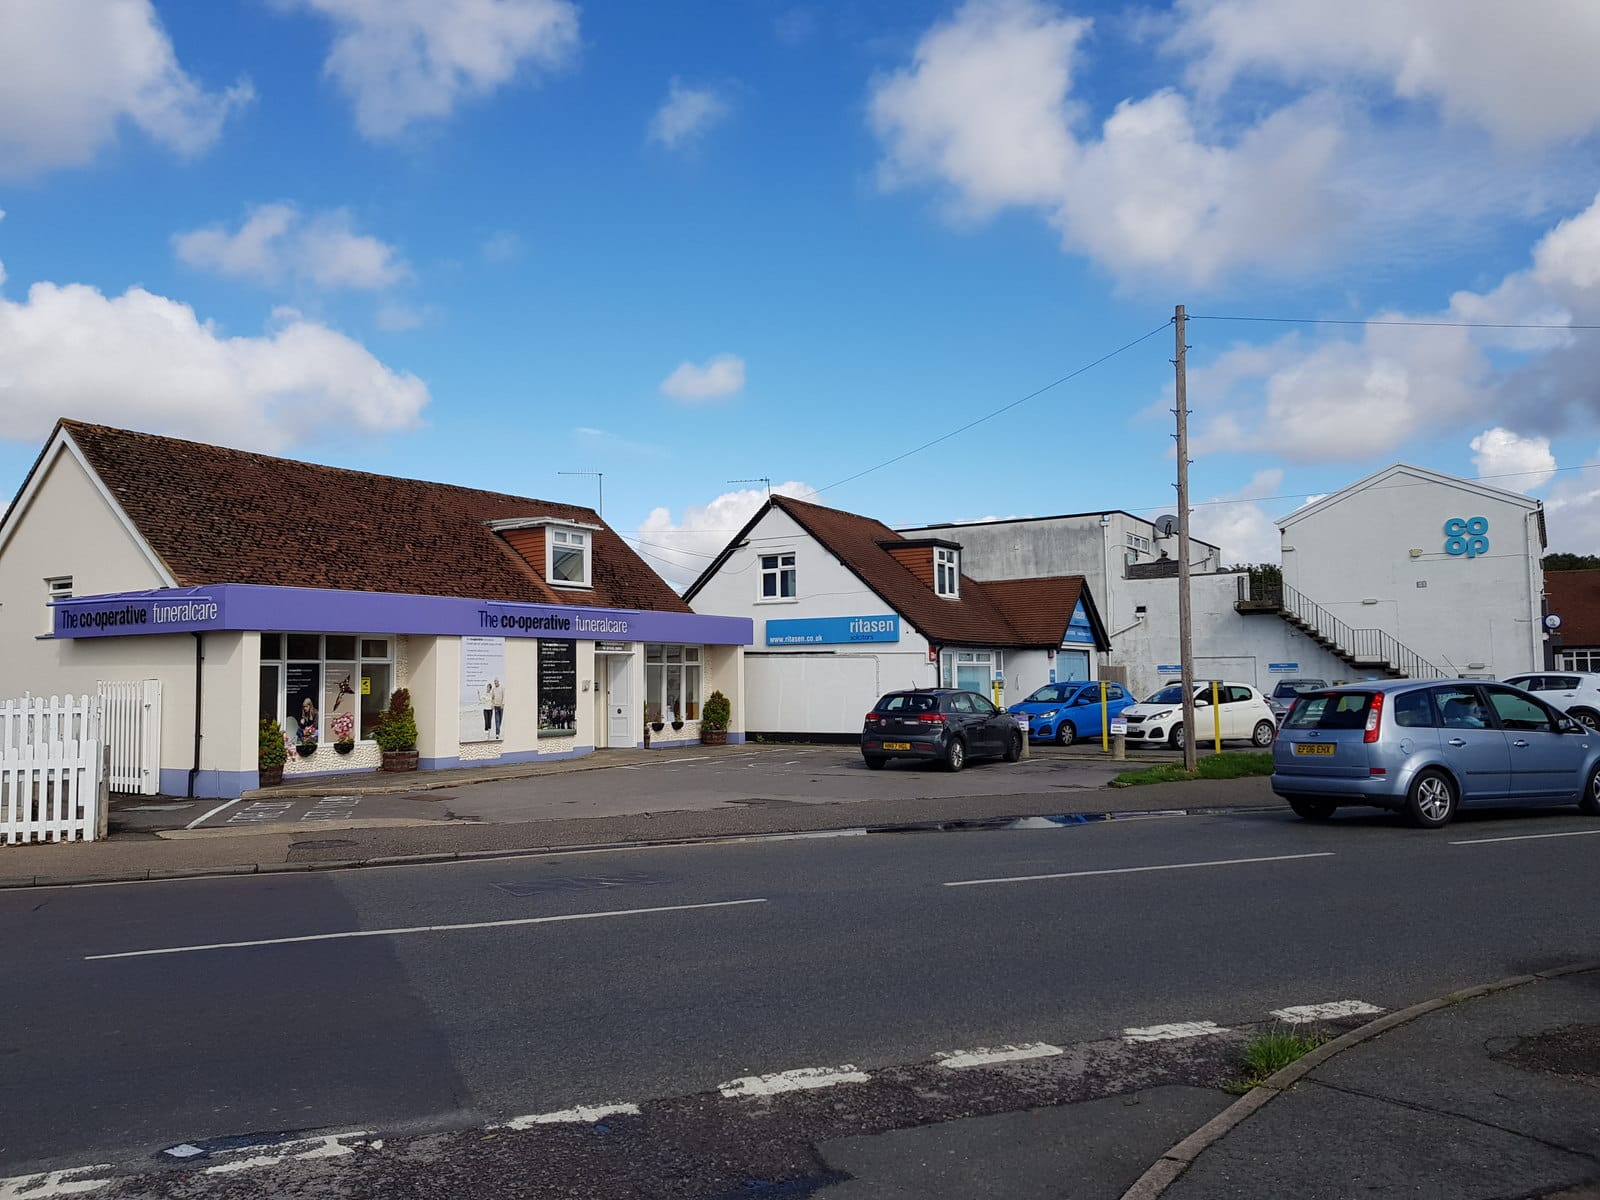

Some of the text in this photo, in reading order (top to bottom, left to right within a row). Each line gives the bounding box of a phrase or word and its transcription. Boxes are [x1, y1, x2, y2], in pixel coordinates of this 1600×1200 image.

[61, 610, 77, 629] The
[153, 601, 217, 624] funeralcare
[478, 610, 498, 628] The
[575, 615, 628, 633] funeralcare
[849, 618, 894, 633] ritasen
[769, 634, 823, 643] www.ritasen.co.uk
